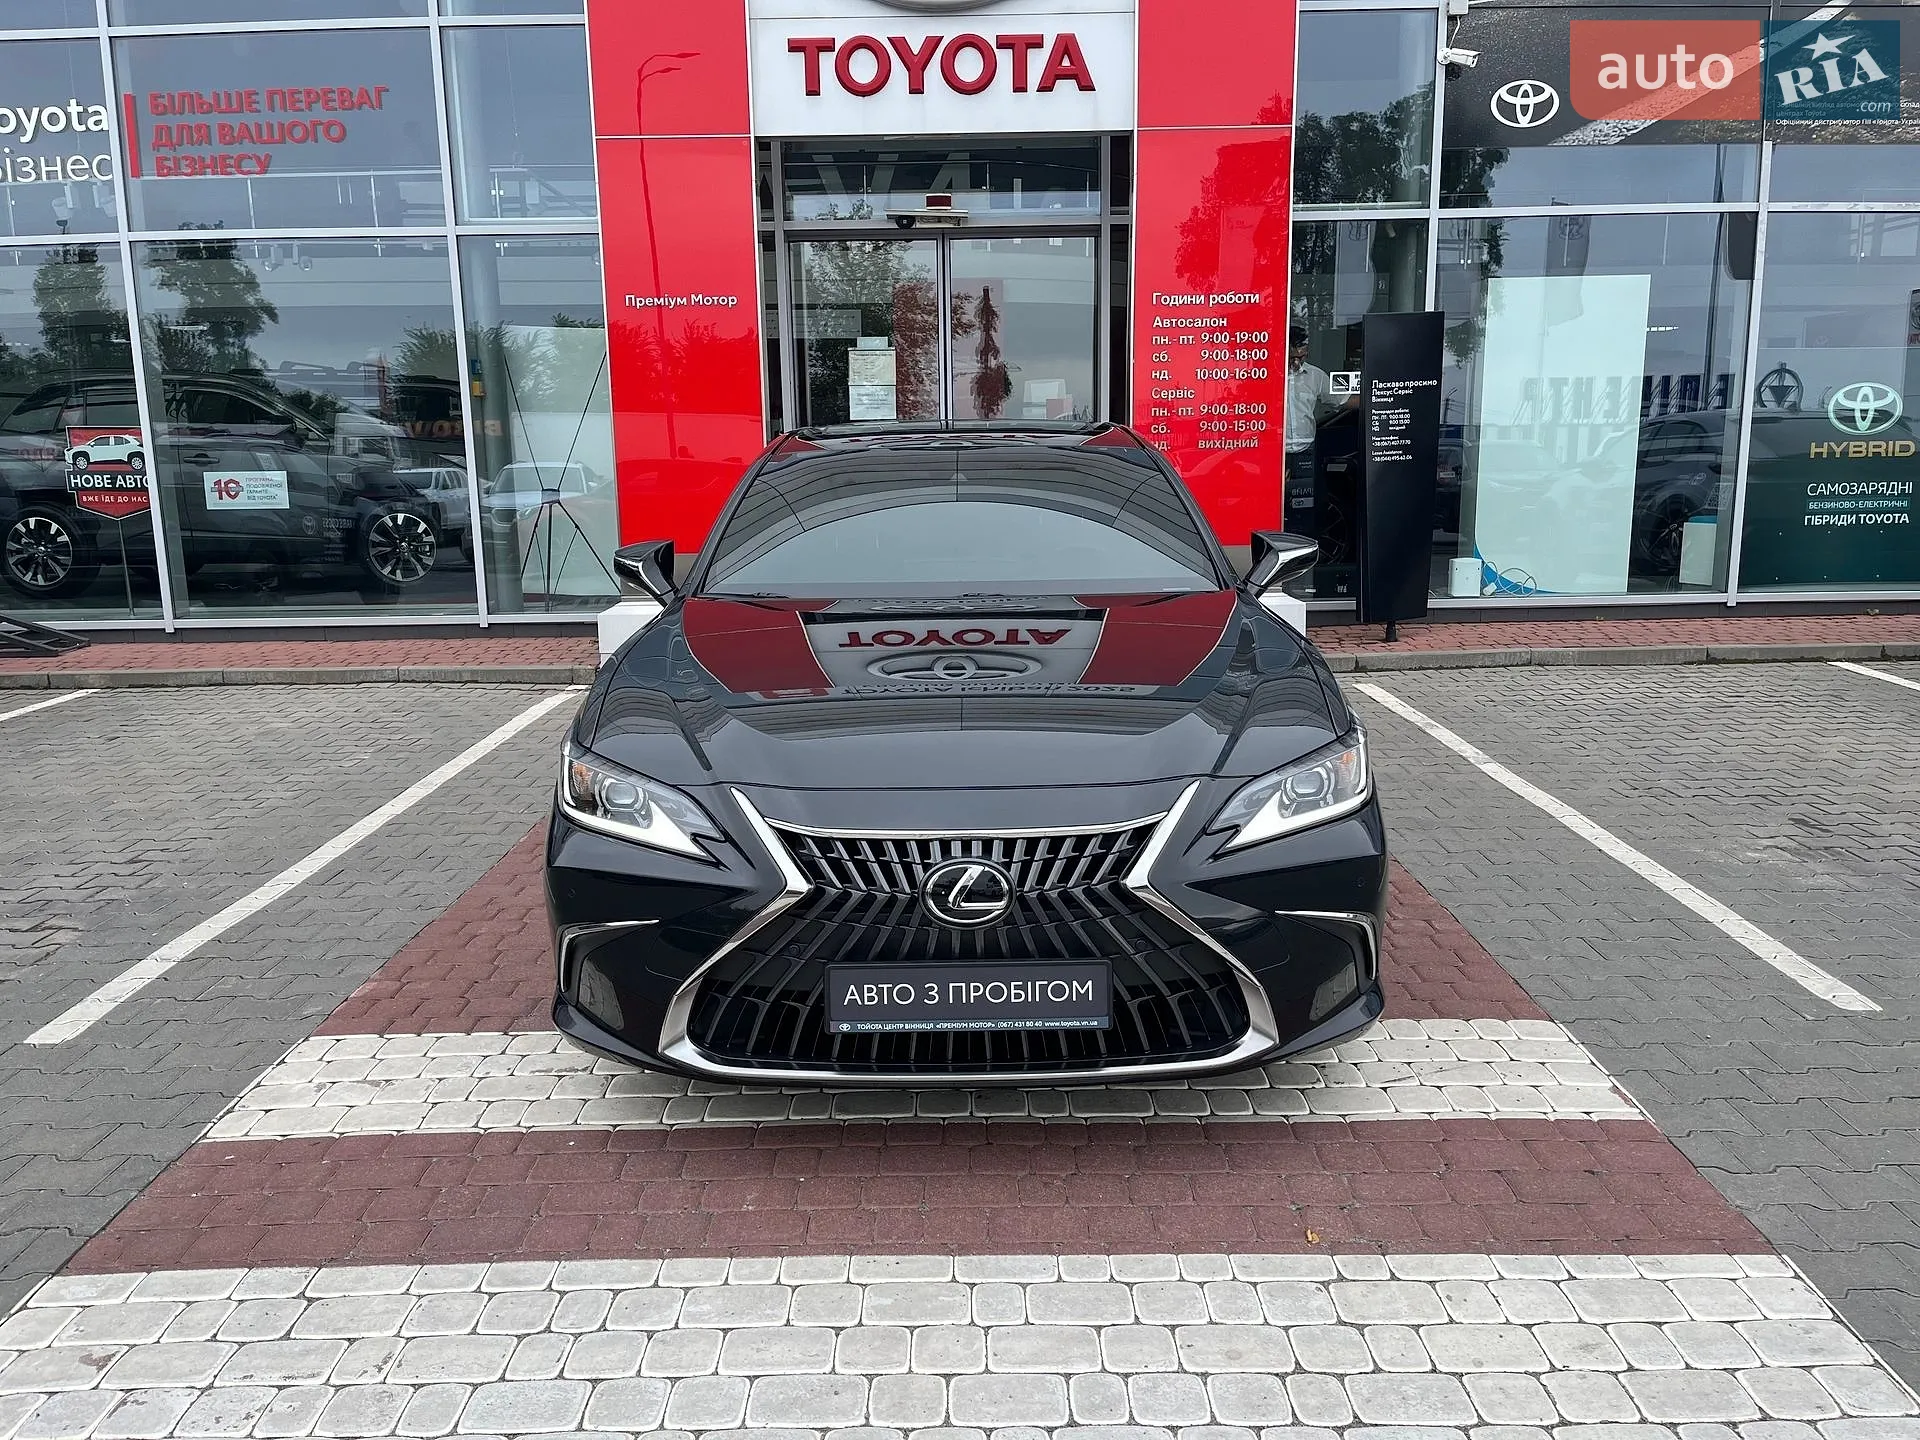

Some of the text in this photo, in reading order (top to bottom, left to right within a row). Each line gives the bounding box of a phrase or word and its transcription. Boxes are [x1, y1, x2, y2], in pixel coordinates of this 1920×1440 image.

[788, 33, 1096, 97] TOYOTA
[149, 85, 389, 116] БІЛЬШЕ ПЕРЕВАГ
[0, 98, 109, 143] oyota
[152, 119, 347, 151] ДЛЯ ВАШОГО
[0, 146, 113, 182] ізнес
[155, 152, 272, 178] БІЗНЕСУ
[625, 293, 738, 309] Преміум Мотор
[1152, 291, 1260, 307] Години роботи
[1152, 316, 1227, 328] Автосалон
[1201, 331, 1269, 344] 9:00-19:00
[1152, 349, 1268, 362] сб. 9:00-18:00
[1152, 368, 1268, 380] нд. 10:00-16:00
[1372, 380, 1437, 389] Ласкаво просимо
[1152, 387, 1195, 400] Сервіс
[1200, 403, 1267, 415] 9:00-18:00
[1151, 420, 1267, 433] сб. 9:00-15:00
[1198, 437, 1259, 450] вихідний
[1809, 440, 1916, 459] HYBRID
[70, 474, 113, 488] НОВЕ
[1807, 481, 1913, 496] САМОЗАРЯДНІ
[101, 494, 114, 503] ЇДЕ
[1804, 513, 1910, 526] ГІБРИДИ TOYOTA
[843, 980, 1093, 1006] АВТО З ПРОБІГОМ
[884, 1023, 904, 1031] ЦЕНТР
[905, 1022, 933, 1030] ВІННИЦЯ
[1044, 1020, 1098, 1029] www.toyota.vn.ua
